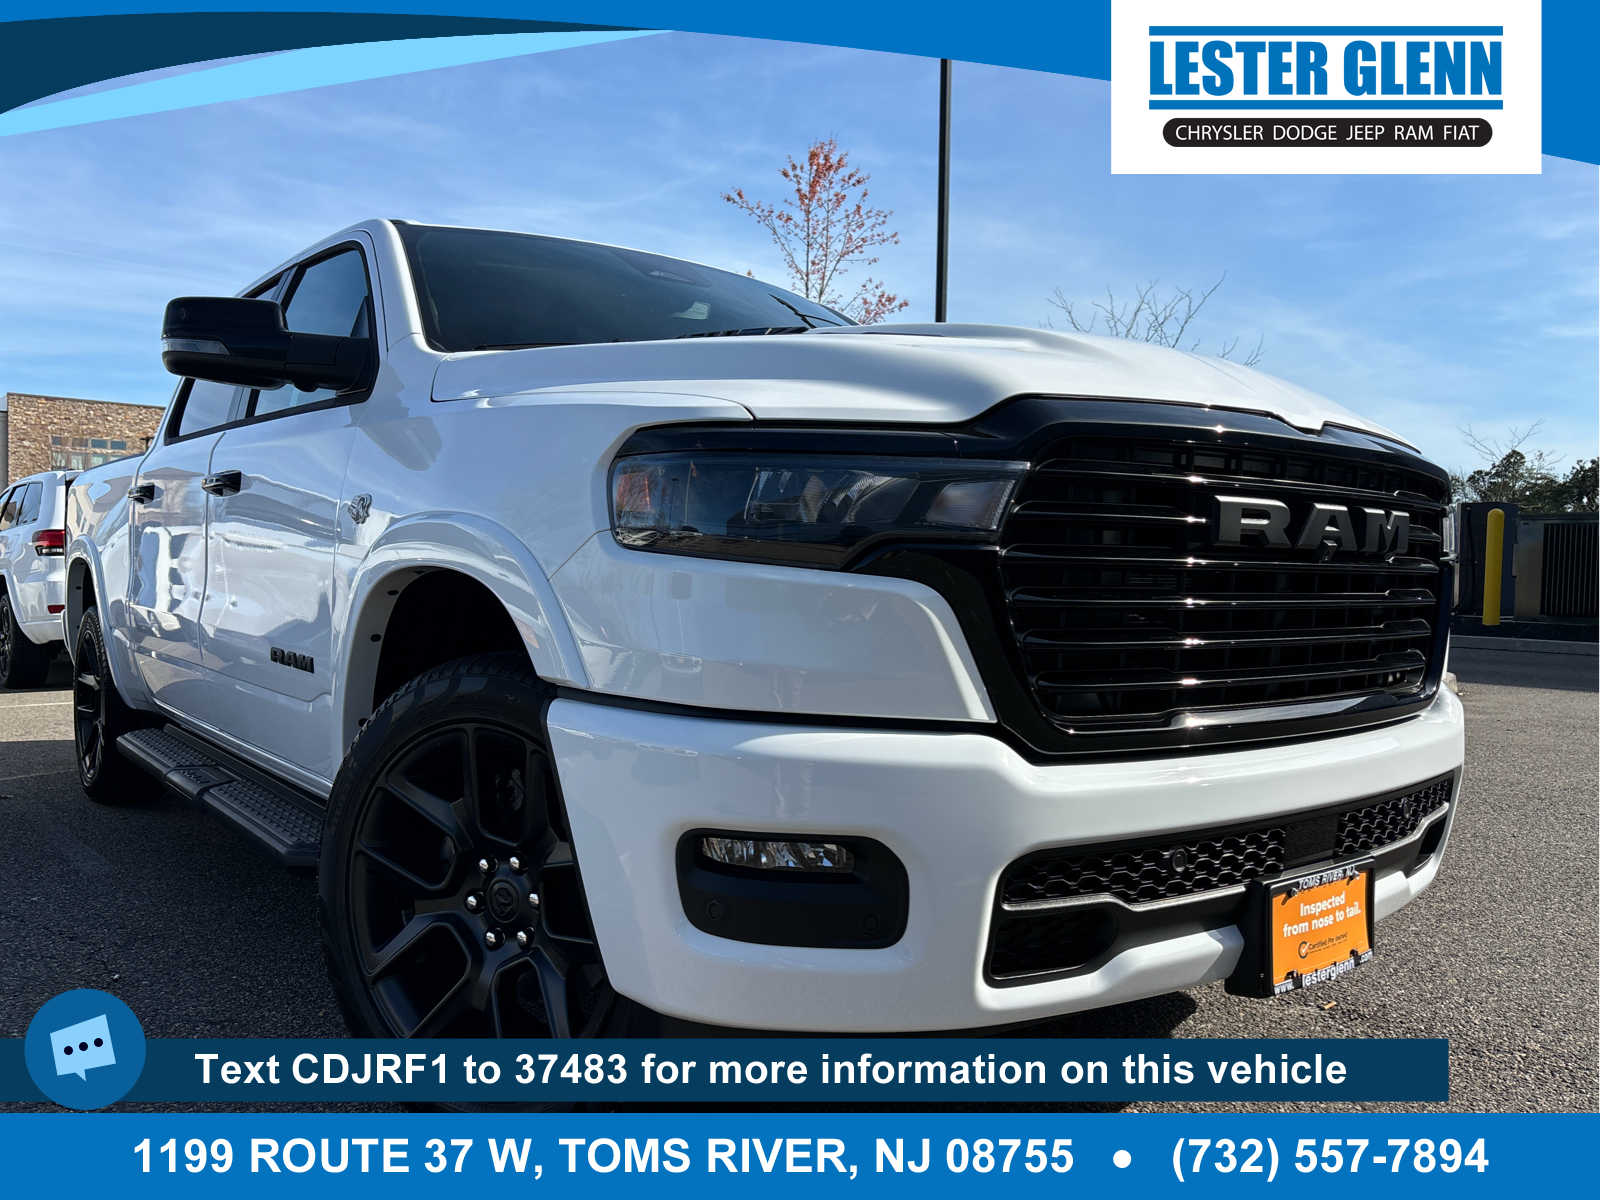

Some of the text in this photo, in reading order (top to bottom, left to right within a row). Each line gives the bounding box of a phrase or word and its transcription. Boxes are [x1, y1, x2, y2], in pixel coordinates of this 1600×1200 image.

[1215, 495, 1410, 553] RAM
[271, 646, 315, 674] RAM
[1298, 875, 1321, 890] TOMS
[1300, 891, 1346, 917] Inspected
[1283, 902, 1361, 937] from nose to tail.
